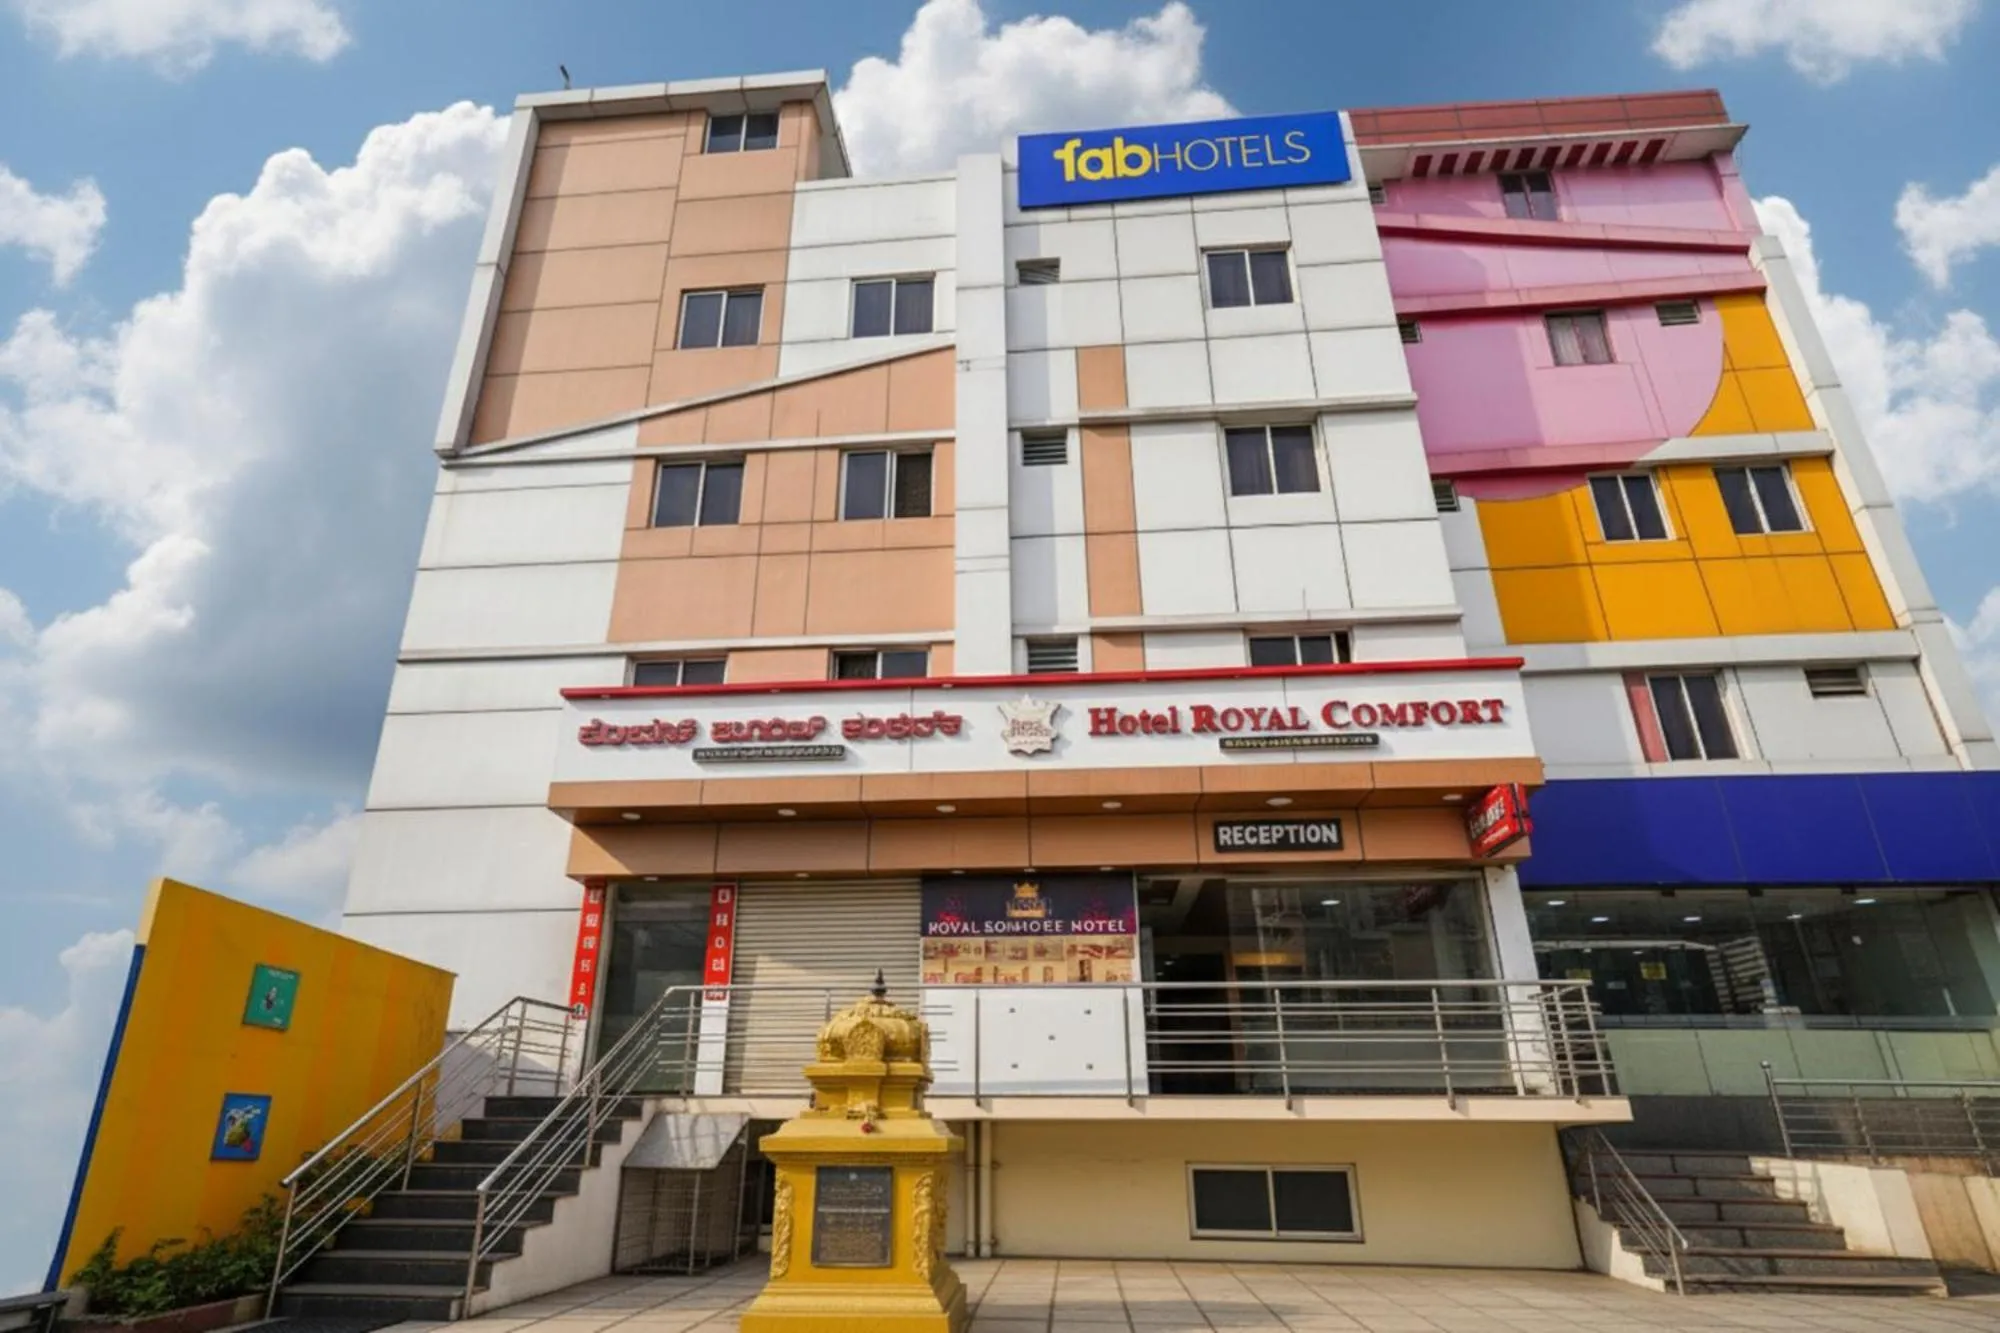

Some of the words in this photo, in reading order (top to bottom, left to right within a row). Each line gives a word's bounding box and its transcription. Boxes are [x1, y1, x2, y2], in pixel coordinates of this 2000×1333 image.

[1053, 130, 1311, 183] fabHOTELS
[1088, 705, 1180, 737] Hotel
[1191, 704, 1309, 734] ROYAL
[1321, 699, 1504, 729] COMFORT
[1217, 823, 1338, 847] RECEPTION
